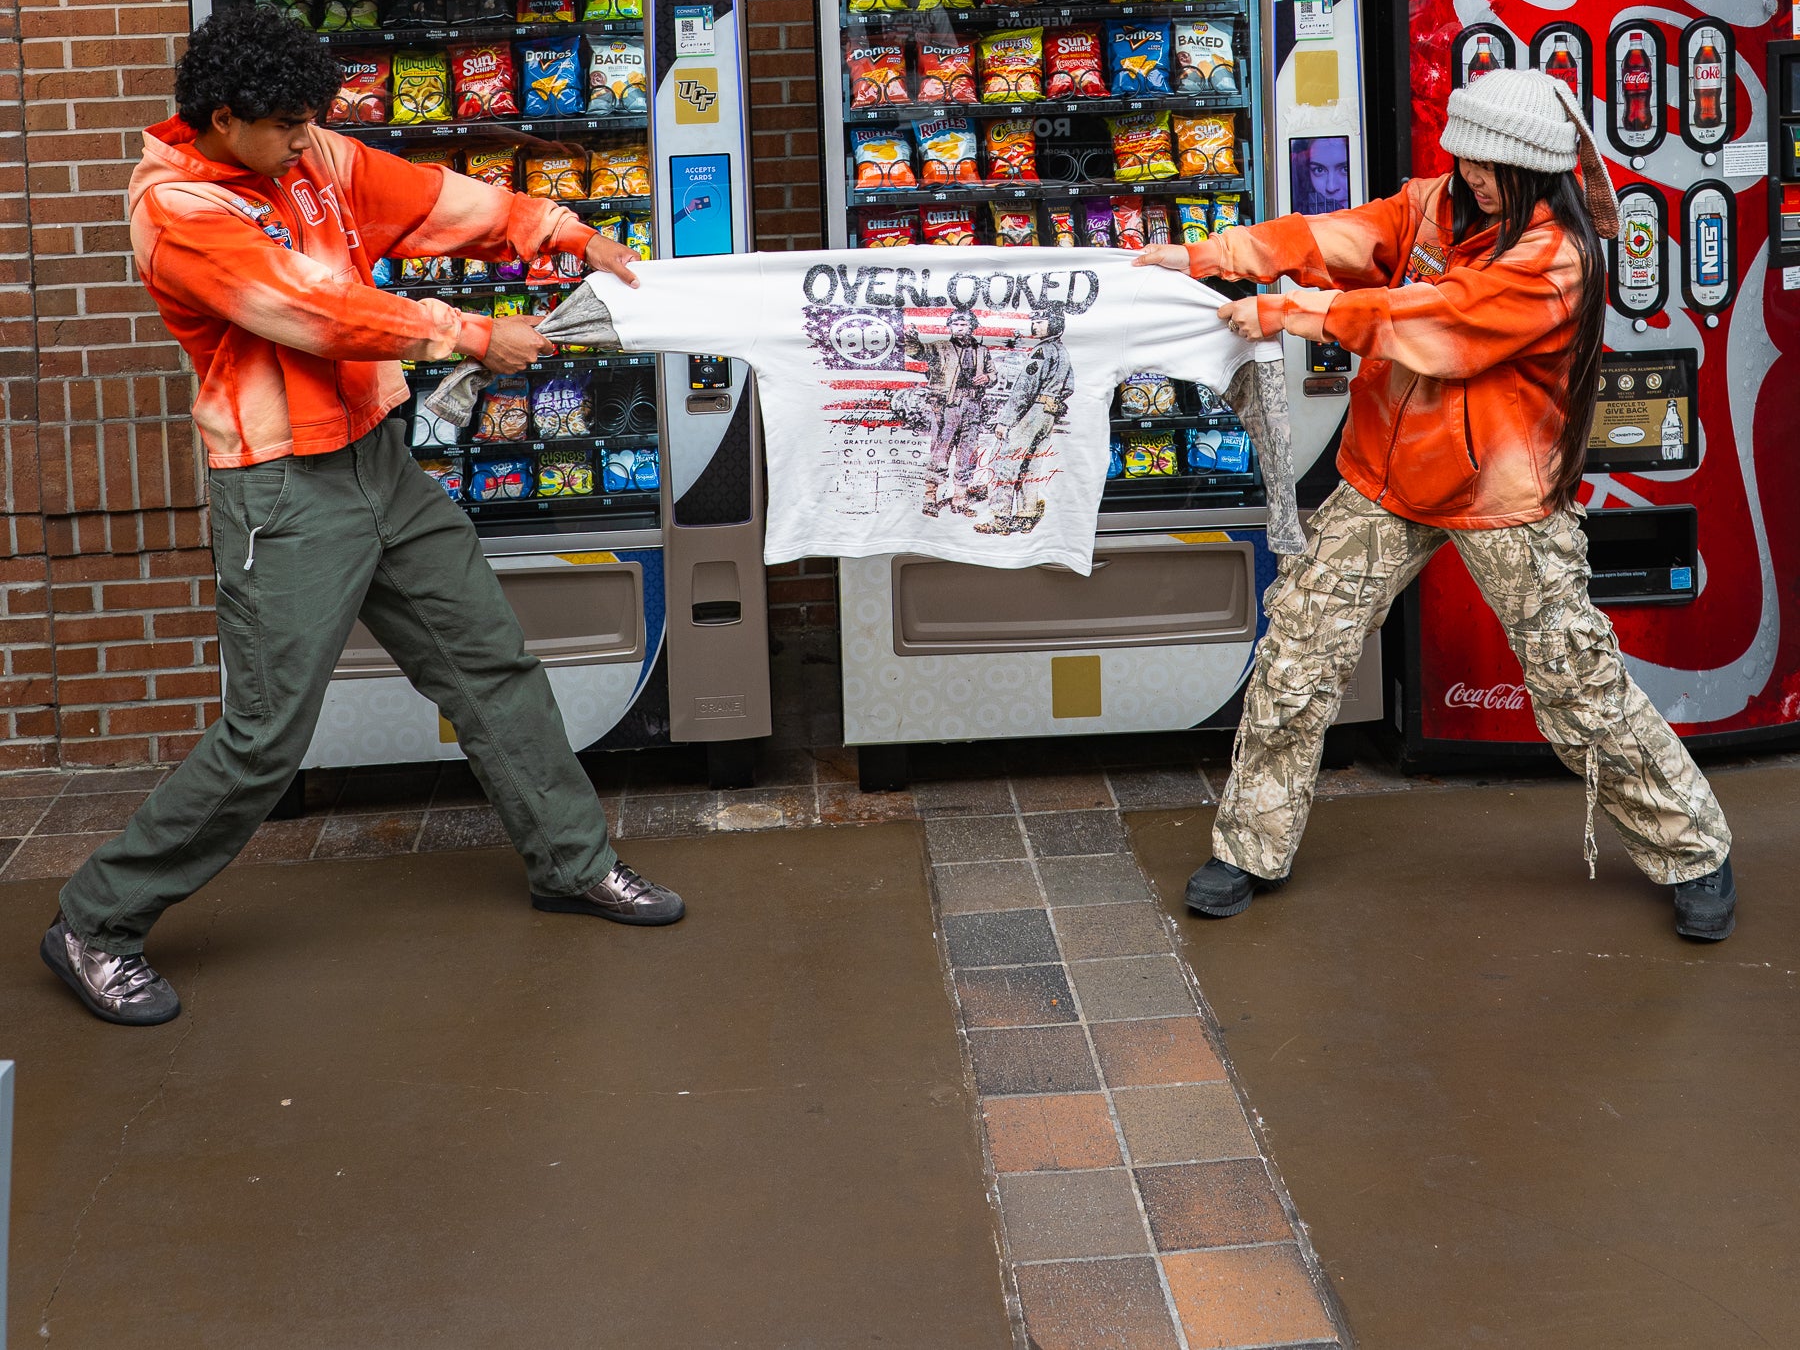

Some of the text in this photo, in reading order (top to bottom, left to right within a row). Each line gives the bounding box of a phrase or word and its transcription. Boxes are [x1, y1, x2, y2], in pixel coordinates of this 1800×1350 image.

[1115, 31, 1162, 42] Doritos
[1178, 35, 1223, 48] BAKED
[923, 45, 970, 55] Doritos
[1058, 36, 1092, 53] Sun
[525, 49, 572, 62] Doritos
[853, 45, 901, 60] Doritos
[463, 55, 496, 76] Sun
[595, 54, 642, 65] BAKED
[340, 62, 377, 73] oritos
[475, 64, 496, 73] CHIPS
[1695, 66, 1720, 80] Coke
[1623, 72, 1650, 84] Coca-Cola
[678, 80, 717, 113] UCF
[934, 109, 945, 117] 203
[1011, 106, 1022, 114] 205
[920, 118, 968, 138] RUFFLES
[991, 120, 1033, 142] Cheetos
[1194, 125, 1223, 140] Sun
[471, 149, 514, 167] Cheetos
[542, 158, 571, 170] Sun
[684, 166, 717, 174] ACCEPTS
[689, 173, 713, 181] CARDS
[1133, 185, 1144, 193] 309
[866, 195, 876, 203] 301
[867, 218, 910, 229] CHEEZ-IT
[927, 211, 969, 224] CHEEZ-IT
[1701, 225, 1718, 274] NOS
[803, 263, 1100, 315] OVERLOOKED
[538, 390, 574, 403] BIG
[535, 399, 579, 410] TEXAS
[969, 442, 1060, 467] Worldwide
[968, 467, 1064, 493] Department
[1444, 682, 1526, 710] Coca-Cola
[701, 702, 741, 713] CRANE
